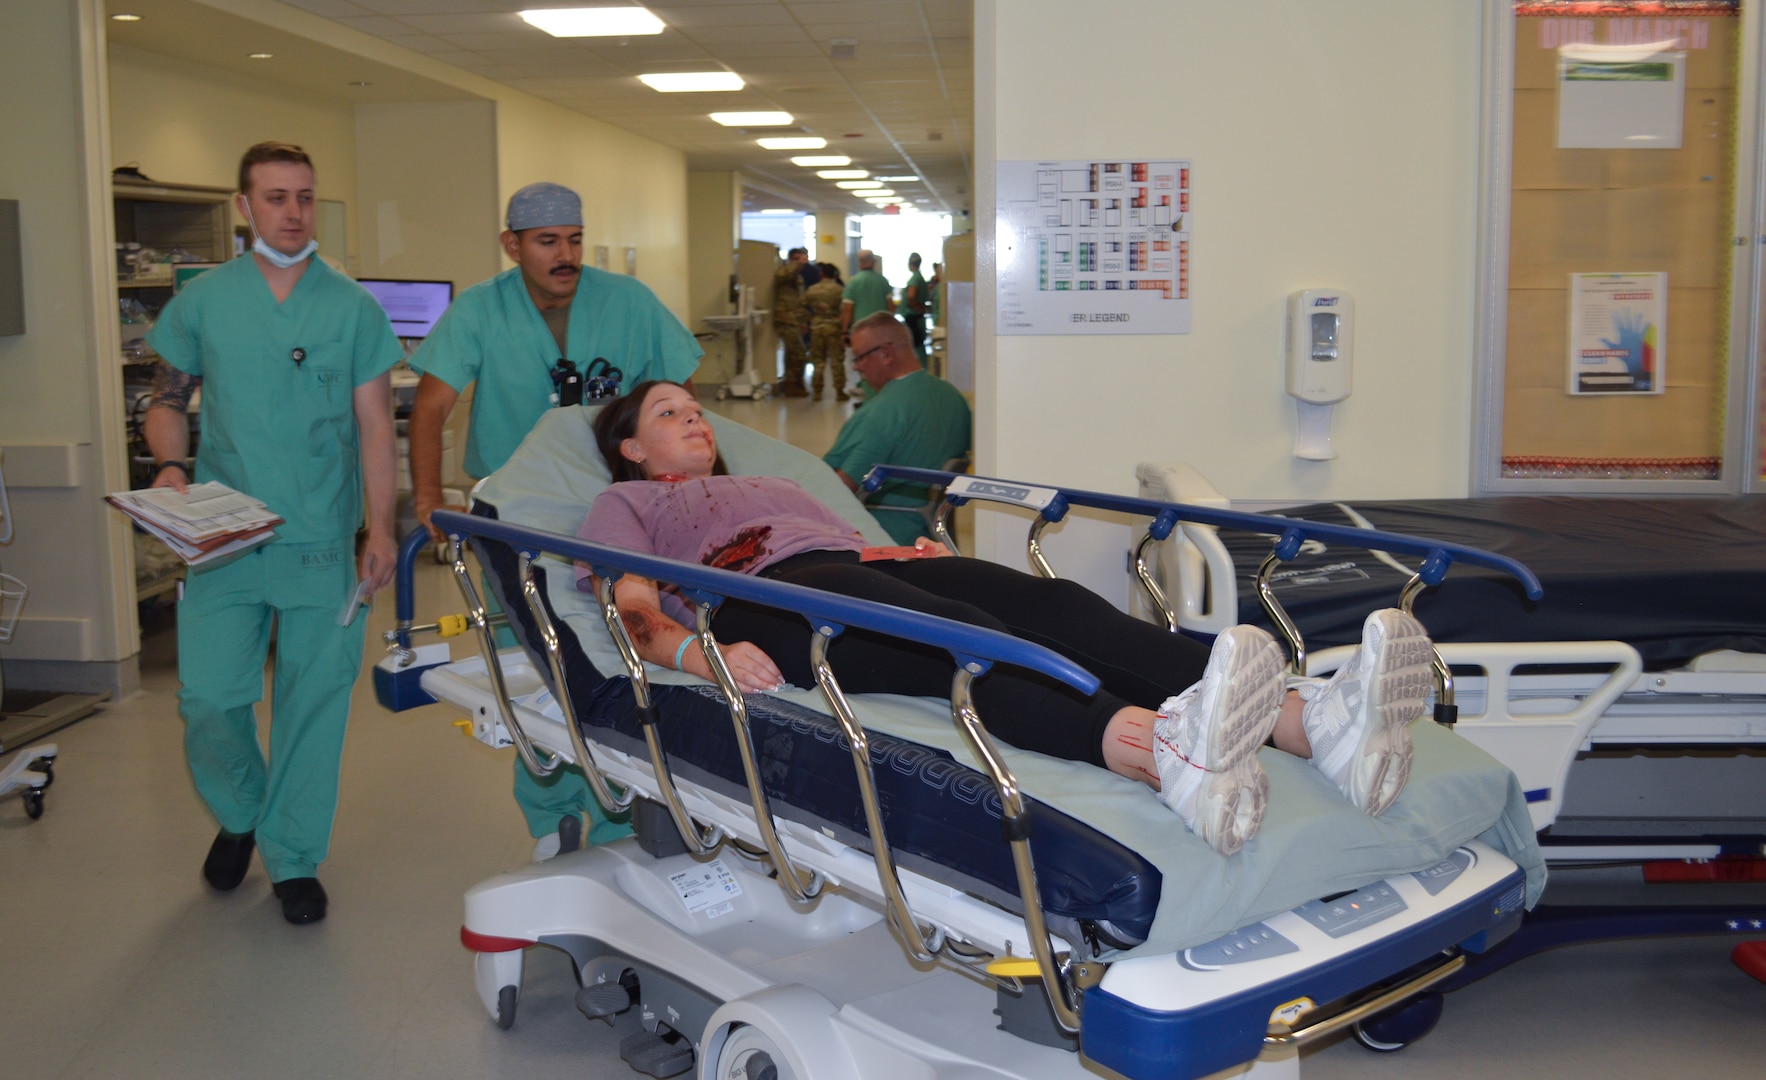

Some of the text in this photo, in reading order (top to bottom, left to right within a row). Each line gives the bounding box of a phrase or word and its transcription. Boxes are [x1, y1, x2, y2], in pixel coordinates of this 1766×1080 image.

[1540, 18, 1709, 49] OUR MARCH
[1072, 313, 1130, 323] ER LEGEND
[302, 550, 344, 566] BAMC
[731, 1067, 742, 1079] BIG
